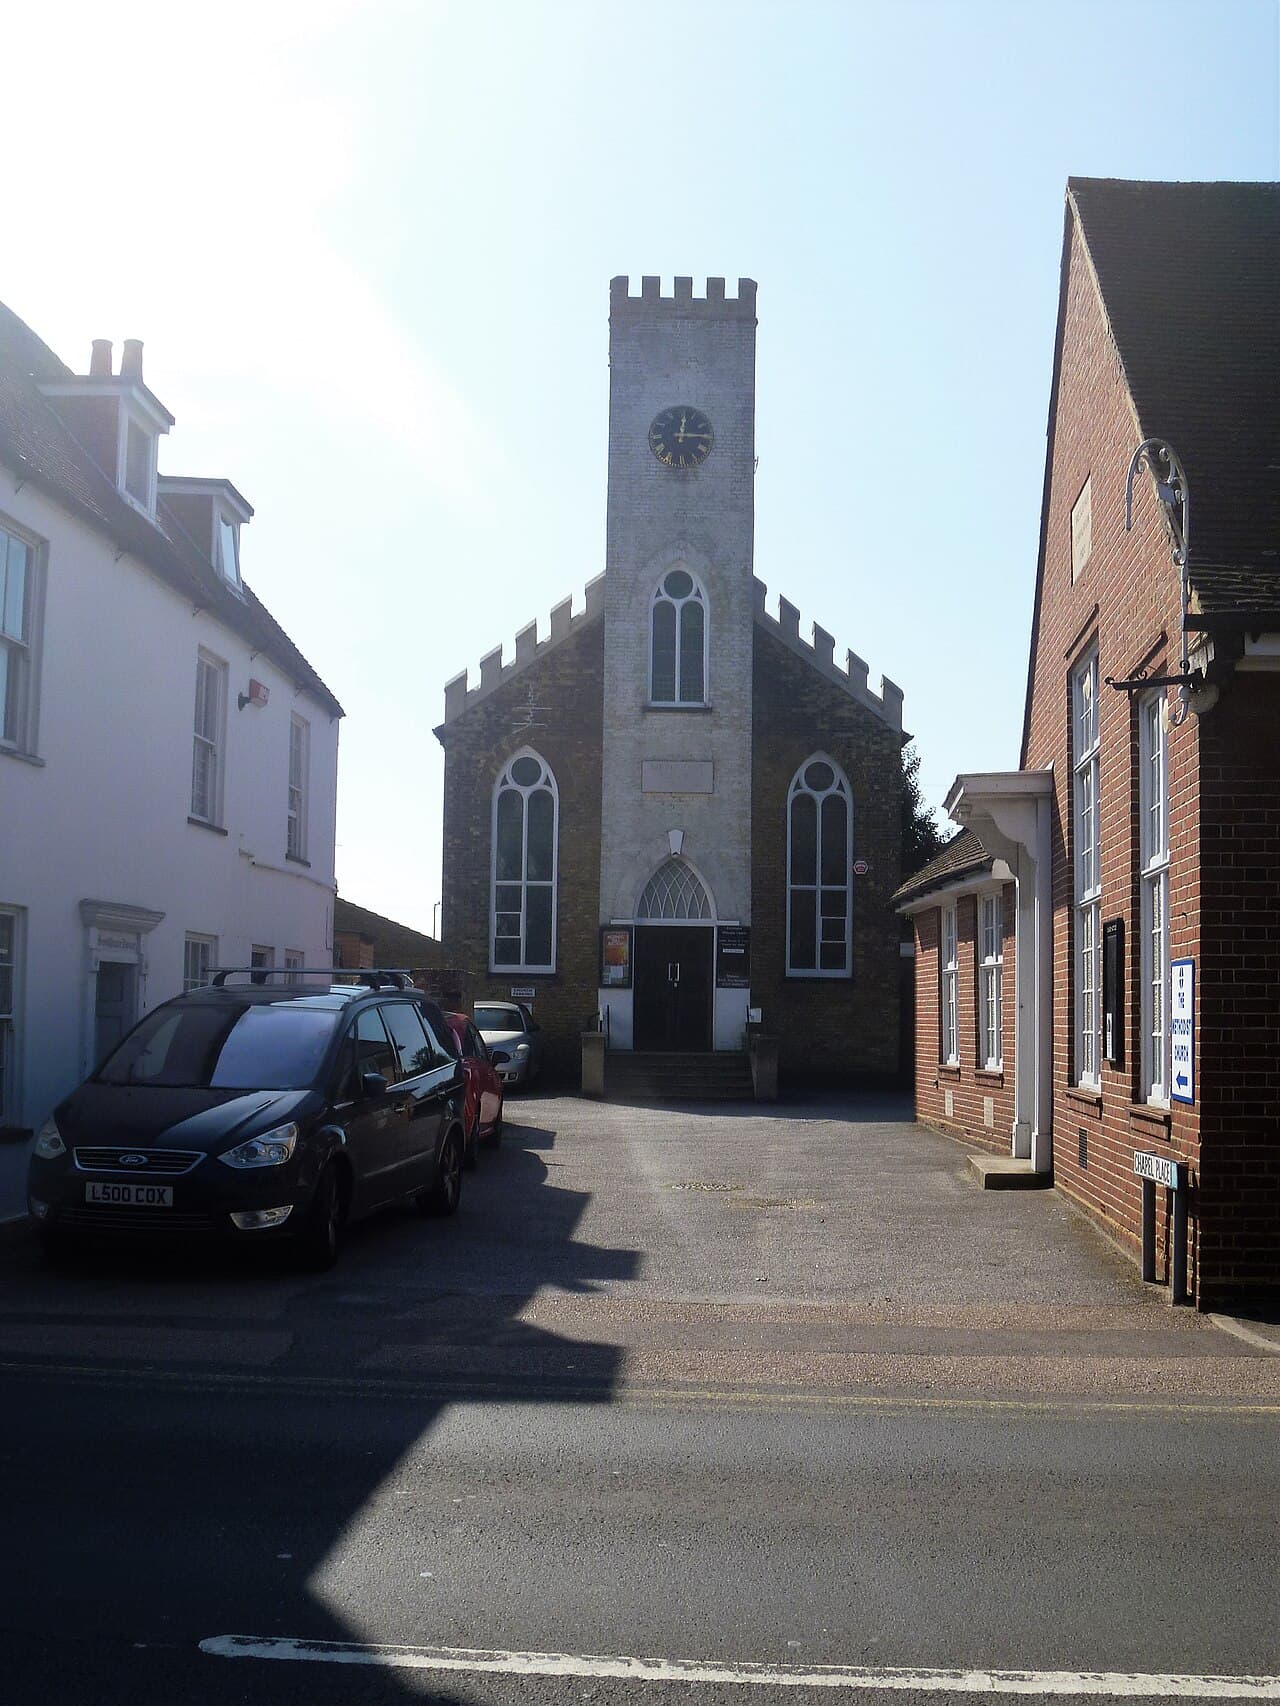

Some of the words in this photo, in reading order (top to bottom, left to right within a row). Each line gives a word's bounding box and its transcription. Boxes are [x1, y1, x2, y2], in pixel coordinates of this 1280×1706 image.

[1134, 1152, 1154, 1178] CHAPEL
[1155, 1159, 1170, 1183] PLACE
[91, 1185, 131, 1202] L500
[135, 1187, 166, 1205] COX
